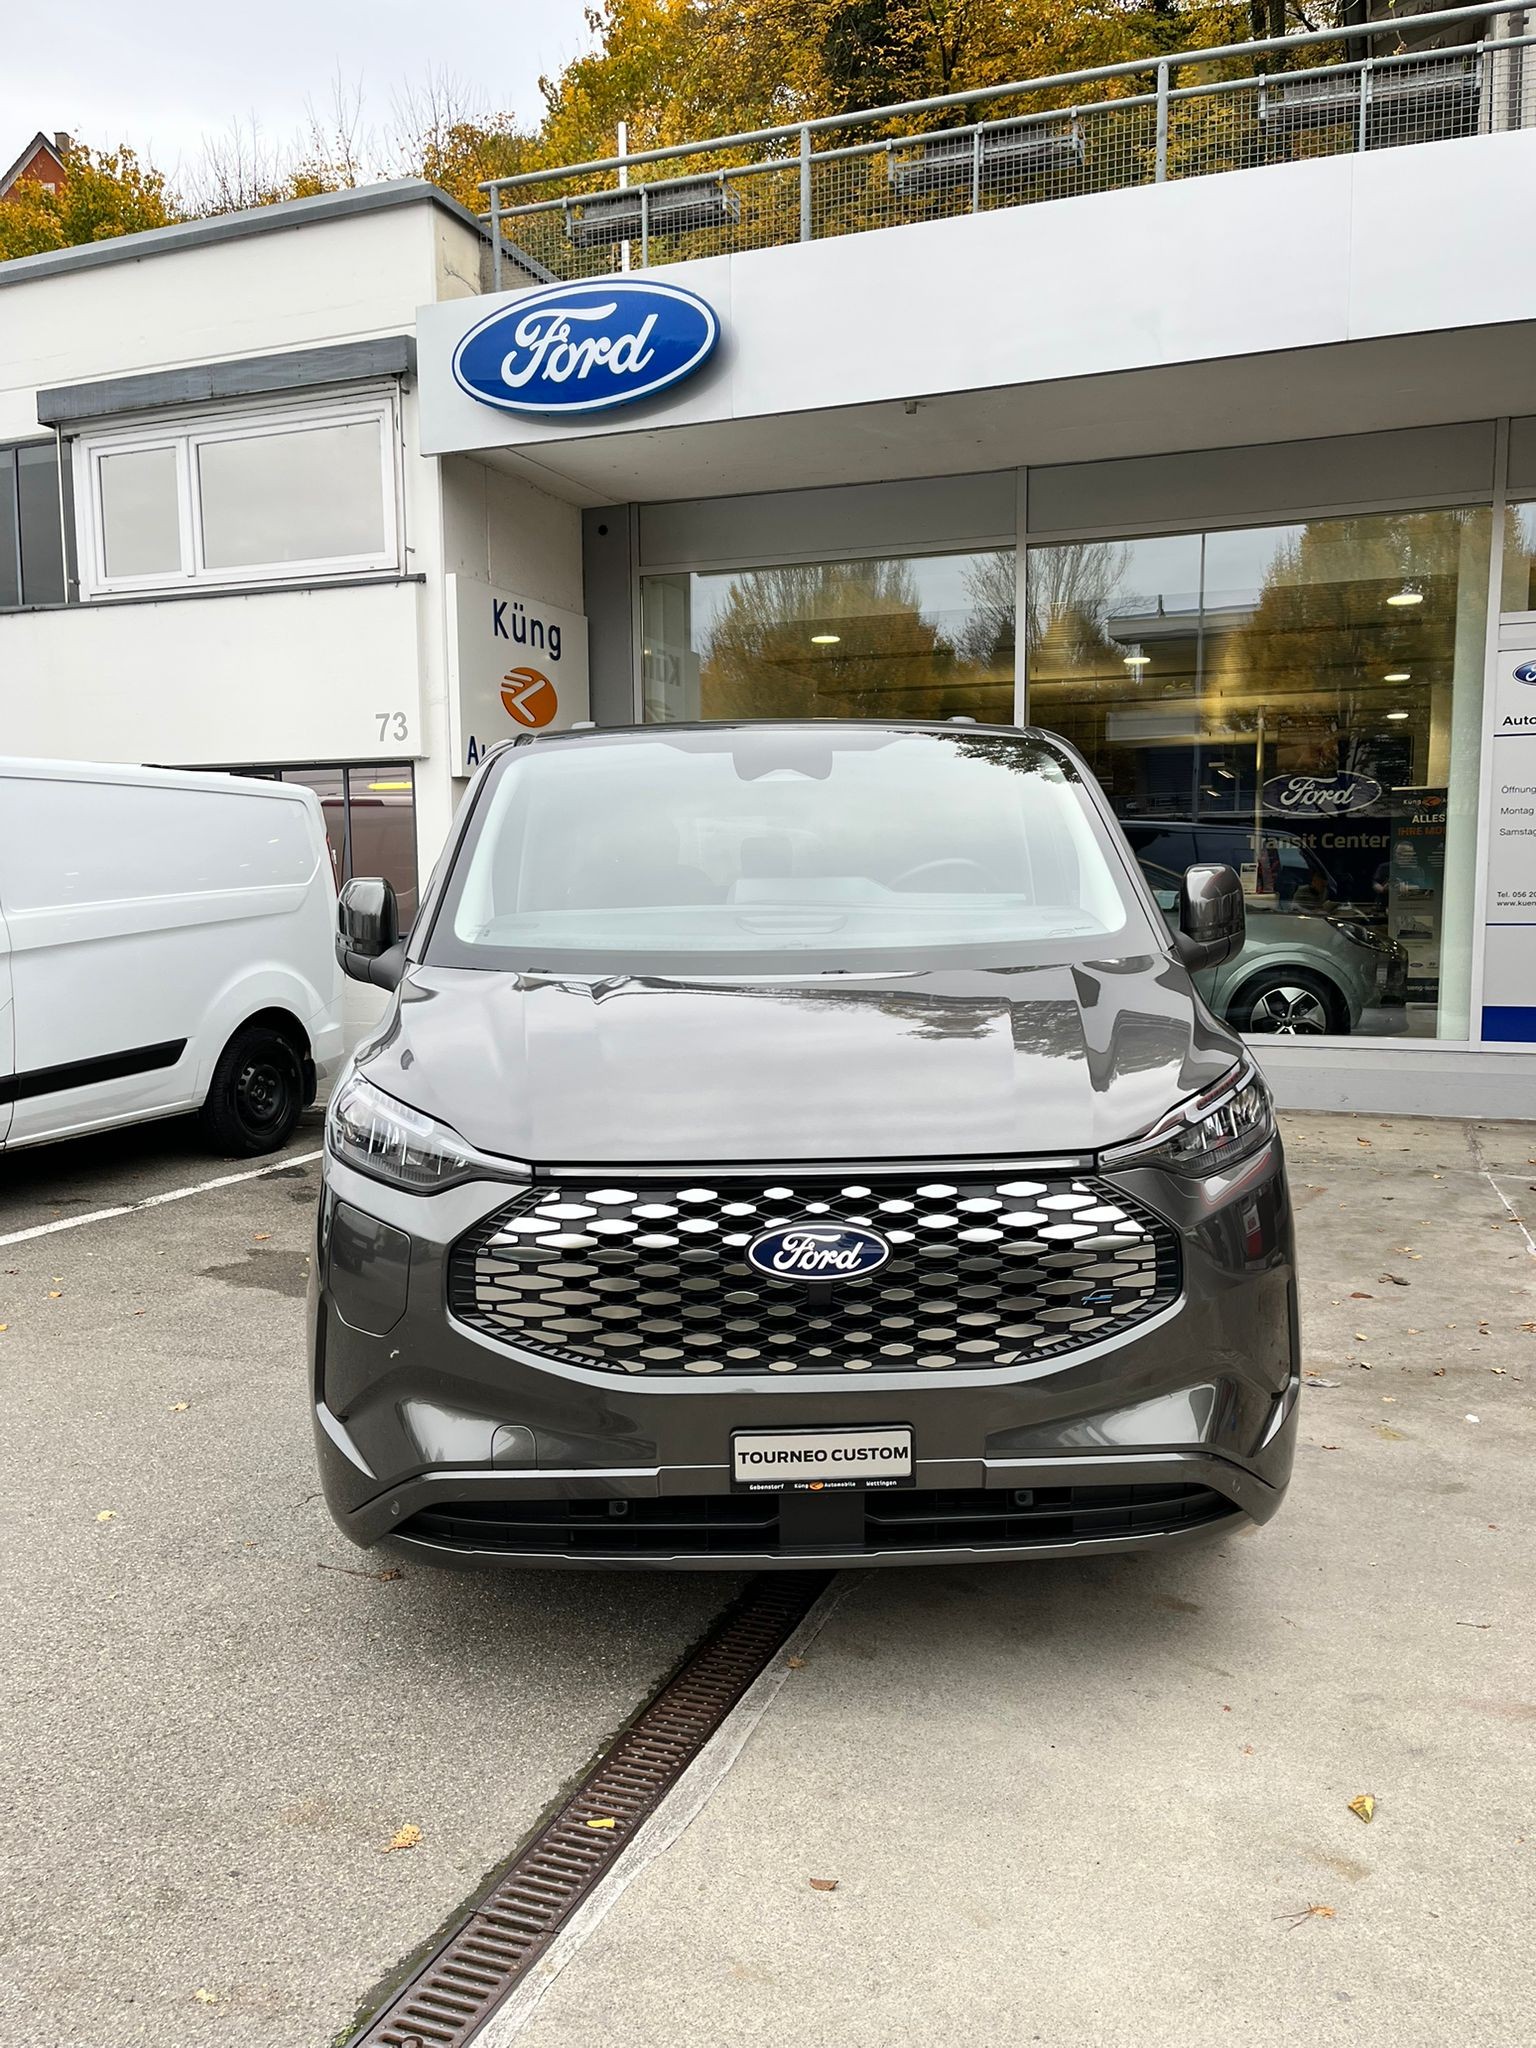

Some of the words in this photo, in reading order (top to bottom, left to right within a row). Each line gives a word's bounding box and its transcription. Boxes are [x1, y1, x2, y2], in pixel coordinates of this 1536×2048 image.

[500, 302, 659, 388] Ford
[492, 599, 562, 661] Küng
[375, 711, 409, 742] 73
[1280, 776, 1356, 806] Ford
[1411, 813, 1446, 824] ALLES
[1500, 807, 1535, 816] Montag
[1246, 833, 1317, 849] Transit
[1321, 832, 1390, 849] Center
[773, 1232, 864, 1270] Ford
[738, 1449, 828, 1465] TOURNEO
[831, 1446, 909, 1462] CUSTOM
